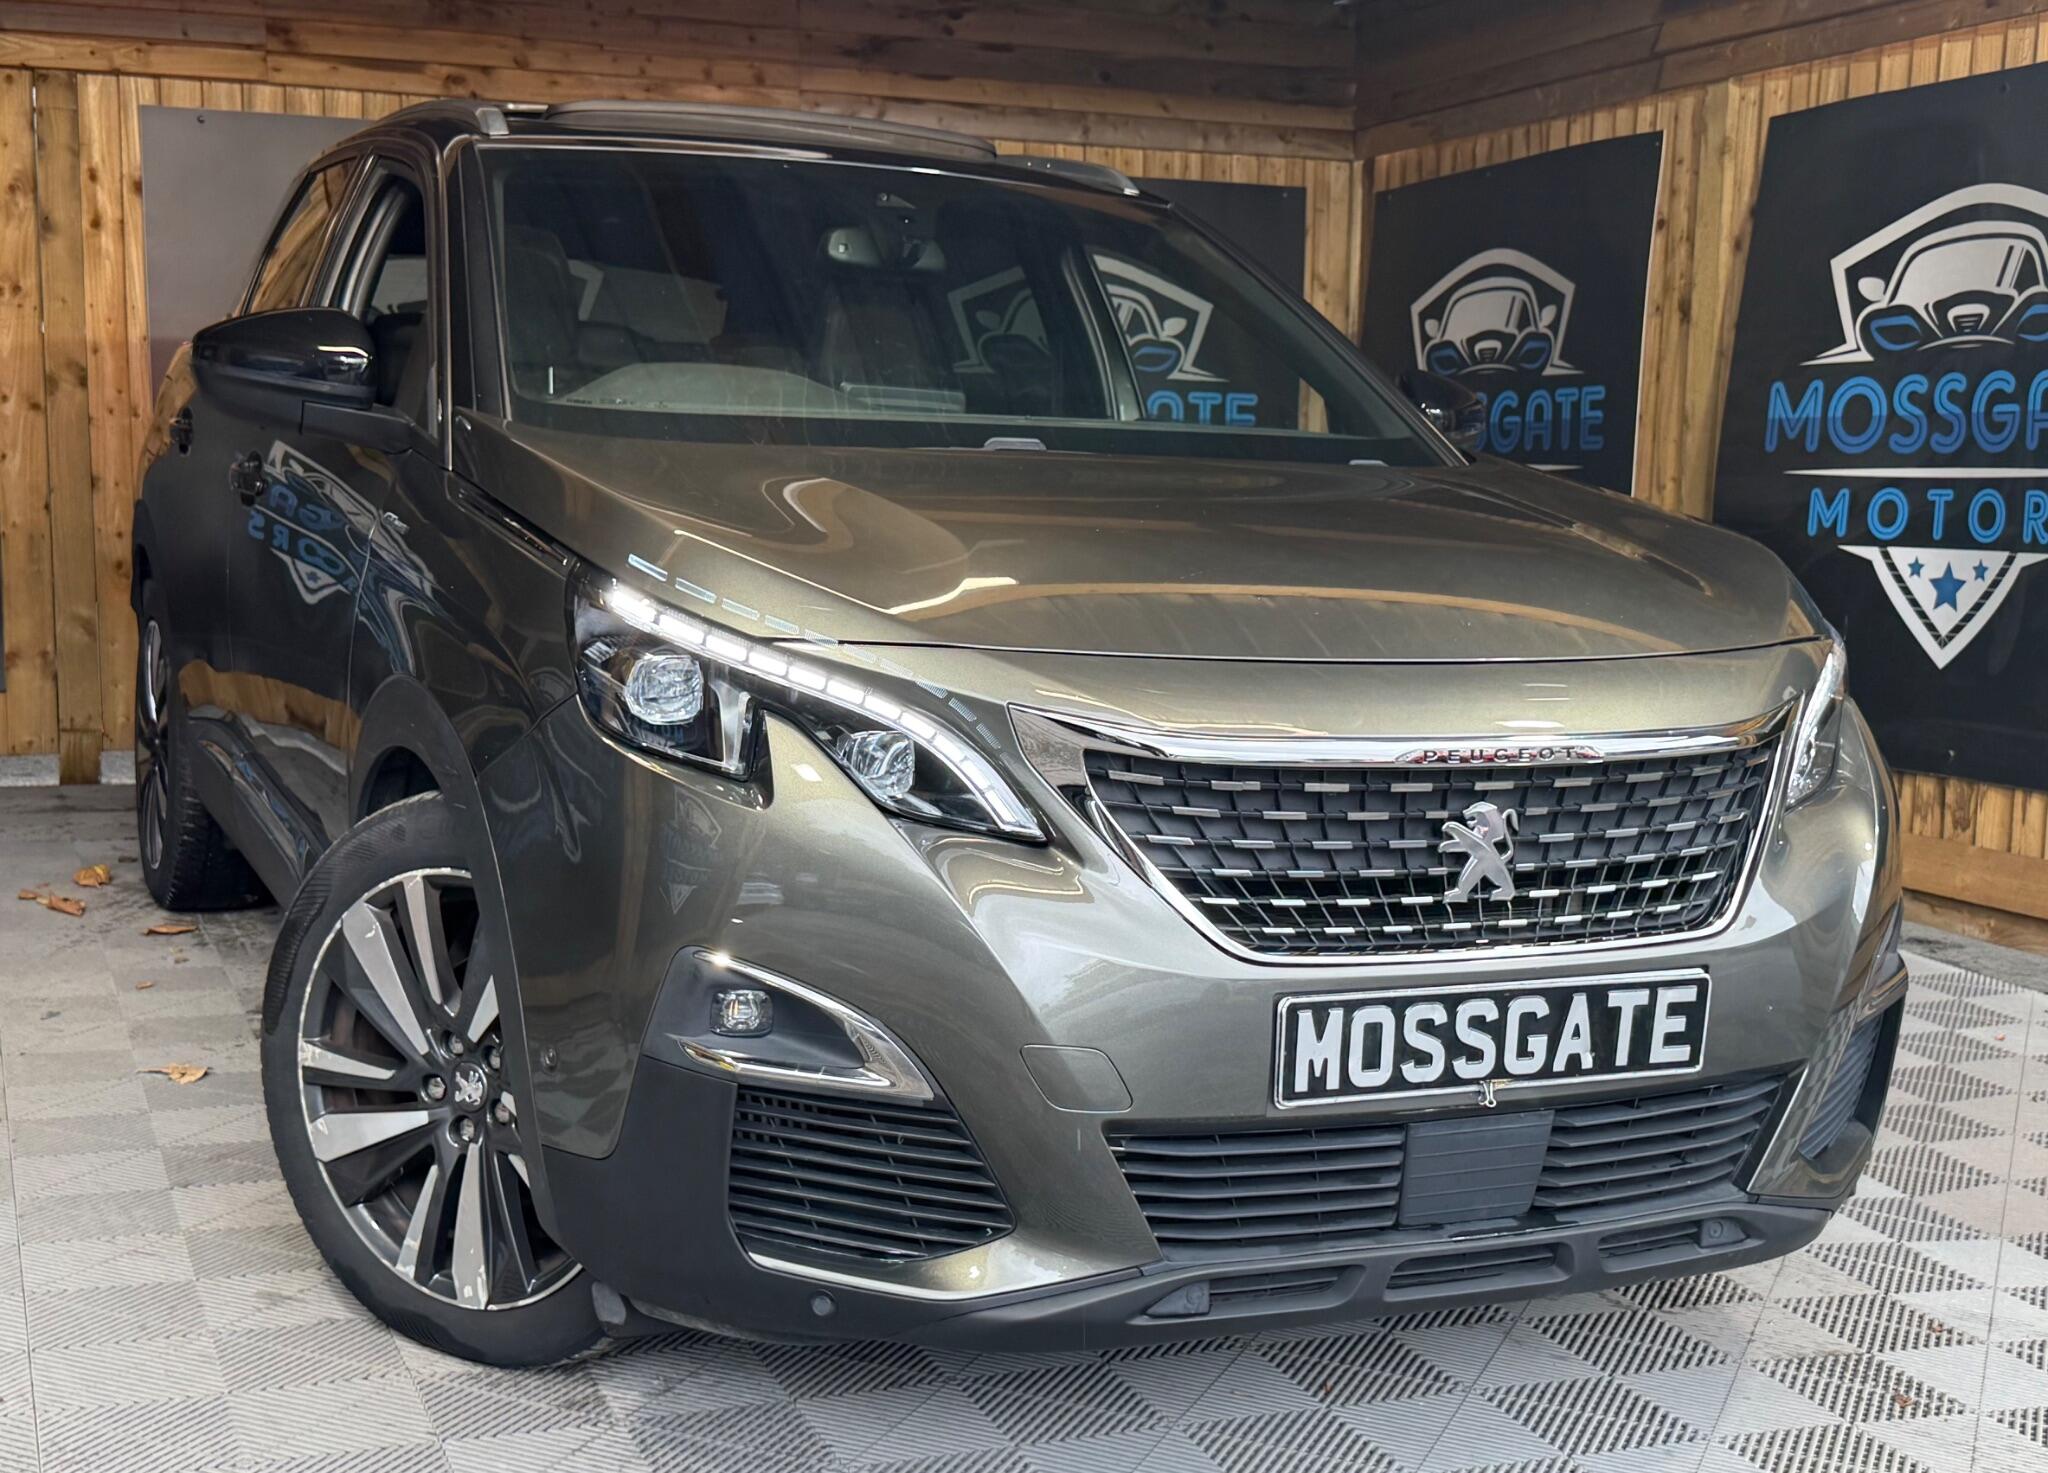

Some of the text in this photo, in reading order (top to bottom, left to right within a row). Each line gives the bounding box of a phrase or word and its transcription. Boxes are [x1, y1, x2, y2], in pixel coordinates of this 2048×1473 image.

[1807, 487, 2048, 544] MOTOR
[1422, 746, 1577, 764] PEUGEOT
[1294, 984, 1698, 1094] MOSSGATE
